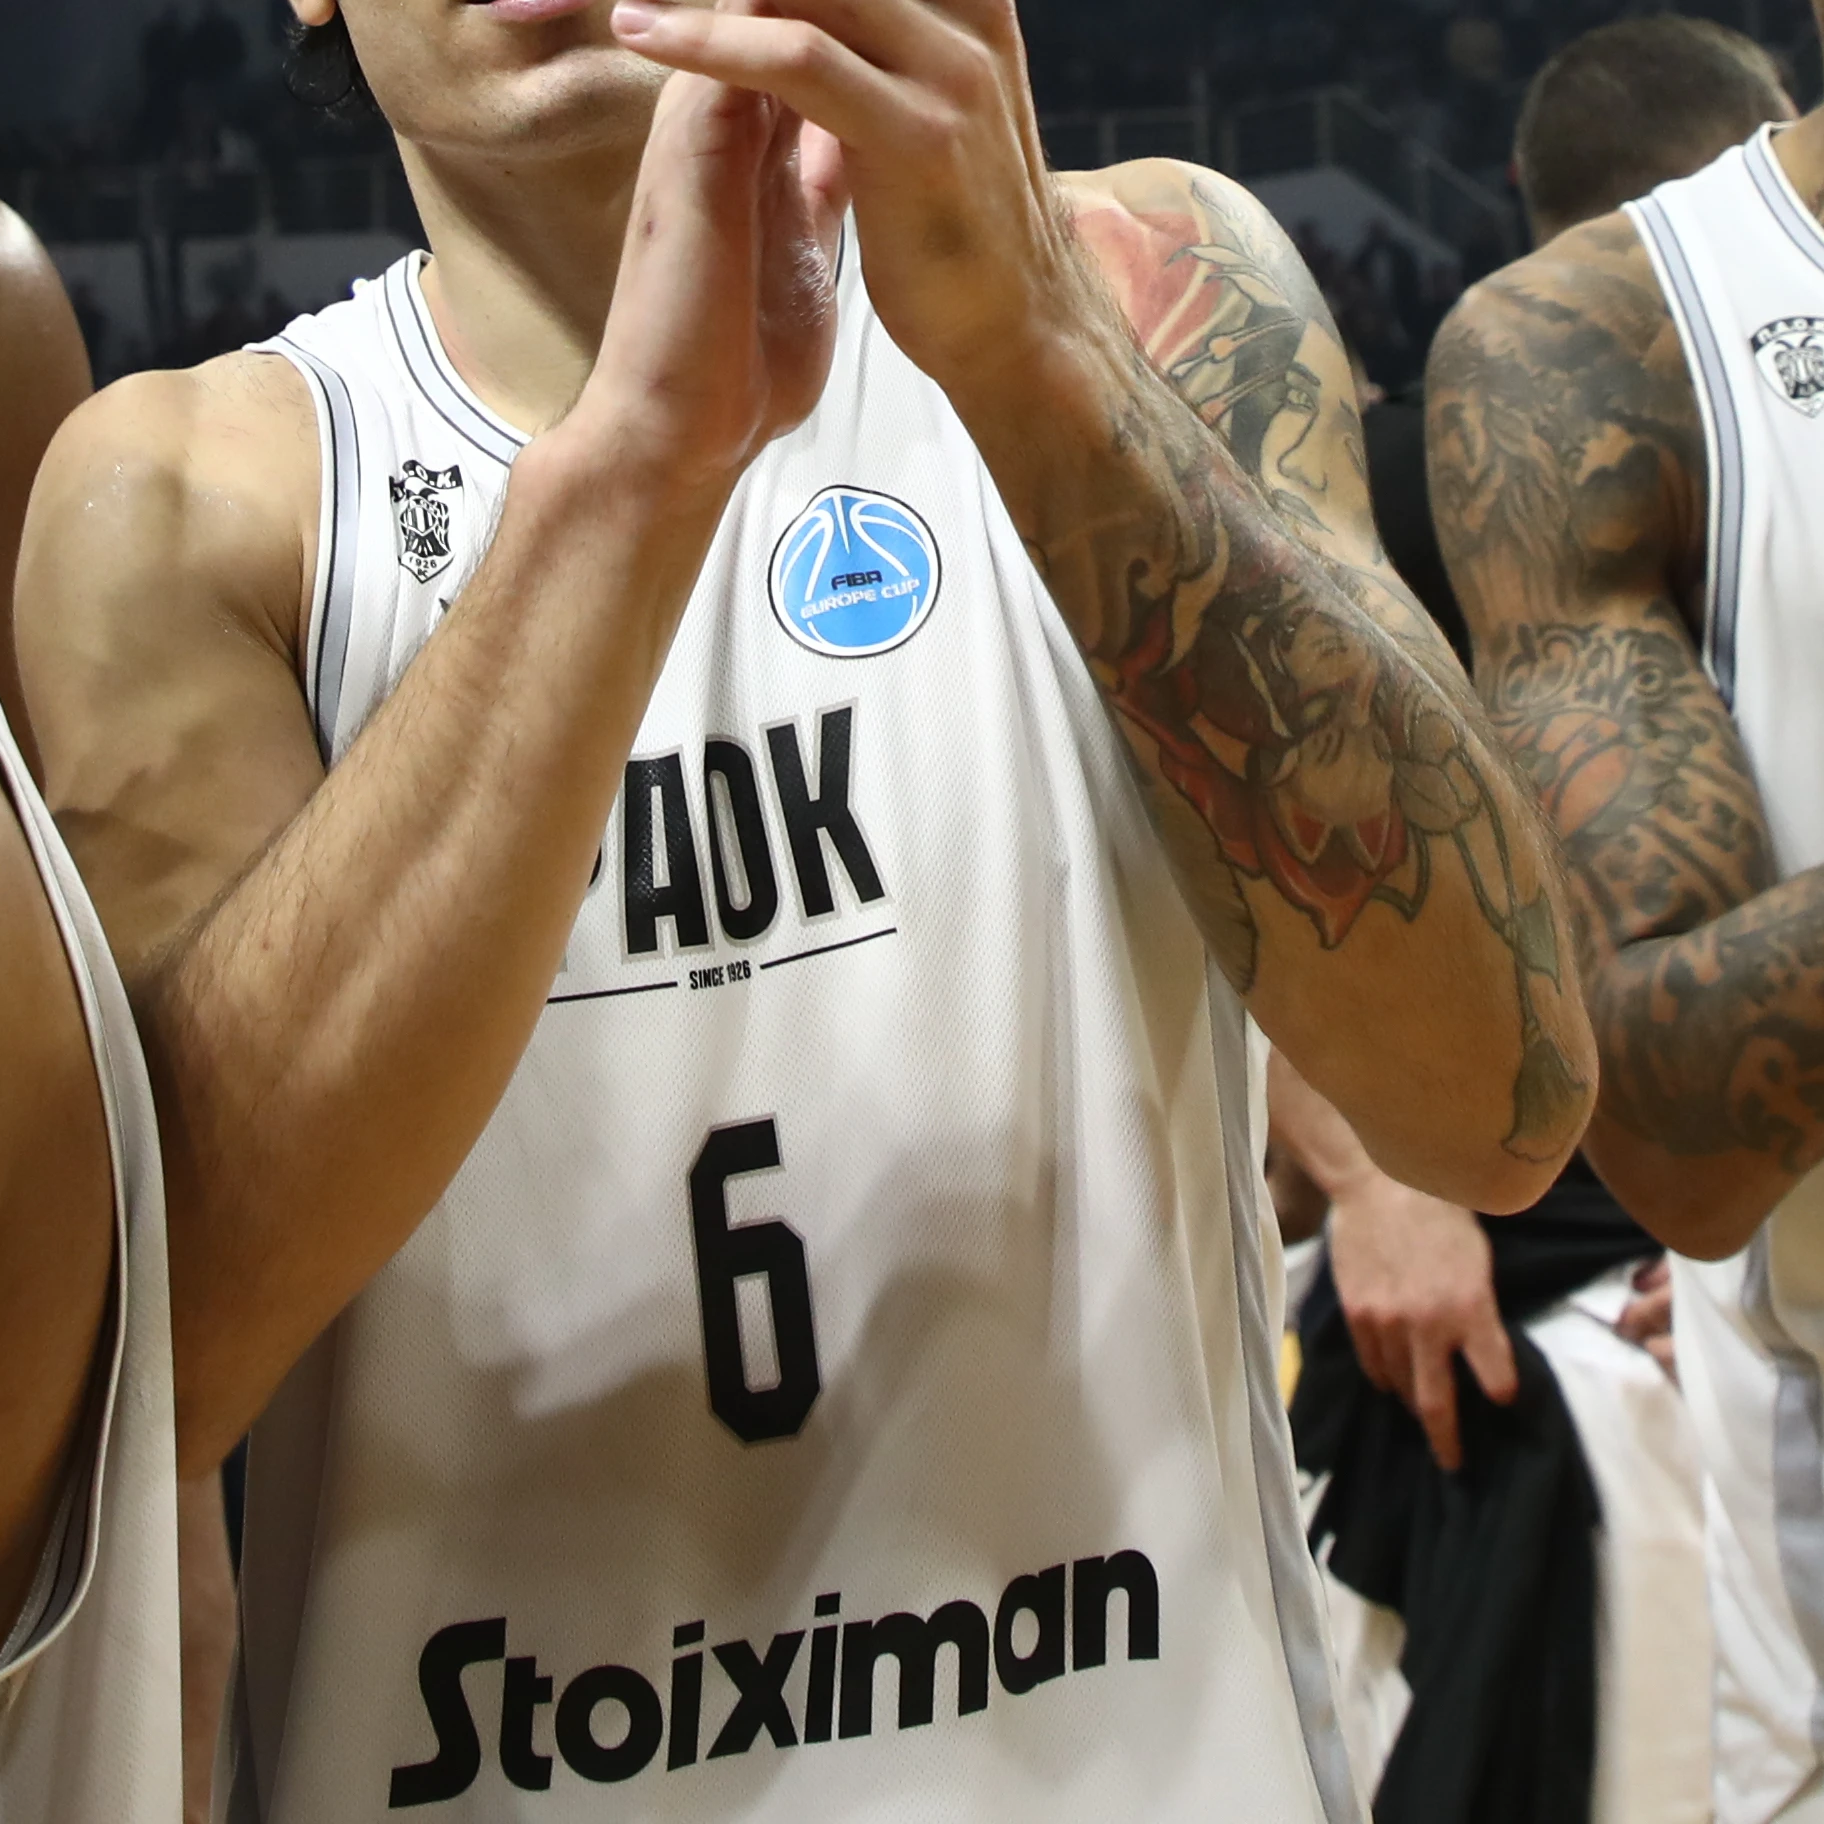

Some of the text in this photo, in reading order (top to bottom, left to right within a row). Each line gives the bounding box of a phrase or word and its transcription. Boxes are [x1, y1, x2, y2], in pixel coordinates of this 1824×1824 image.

[800, 578, 921, 619] EUROPE CUP
[831, 570, 883, 590] FIBA
[584, 706, 886, 955] AOK
[689, 959, 752, 990] SINCE 1926
[689, 1113, 821, 1447] 6
[388, 1548, 1160, 1809] Stoiximan
